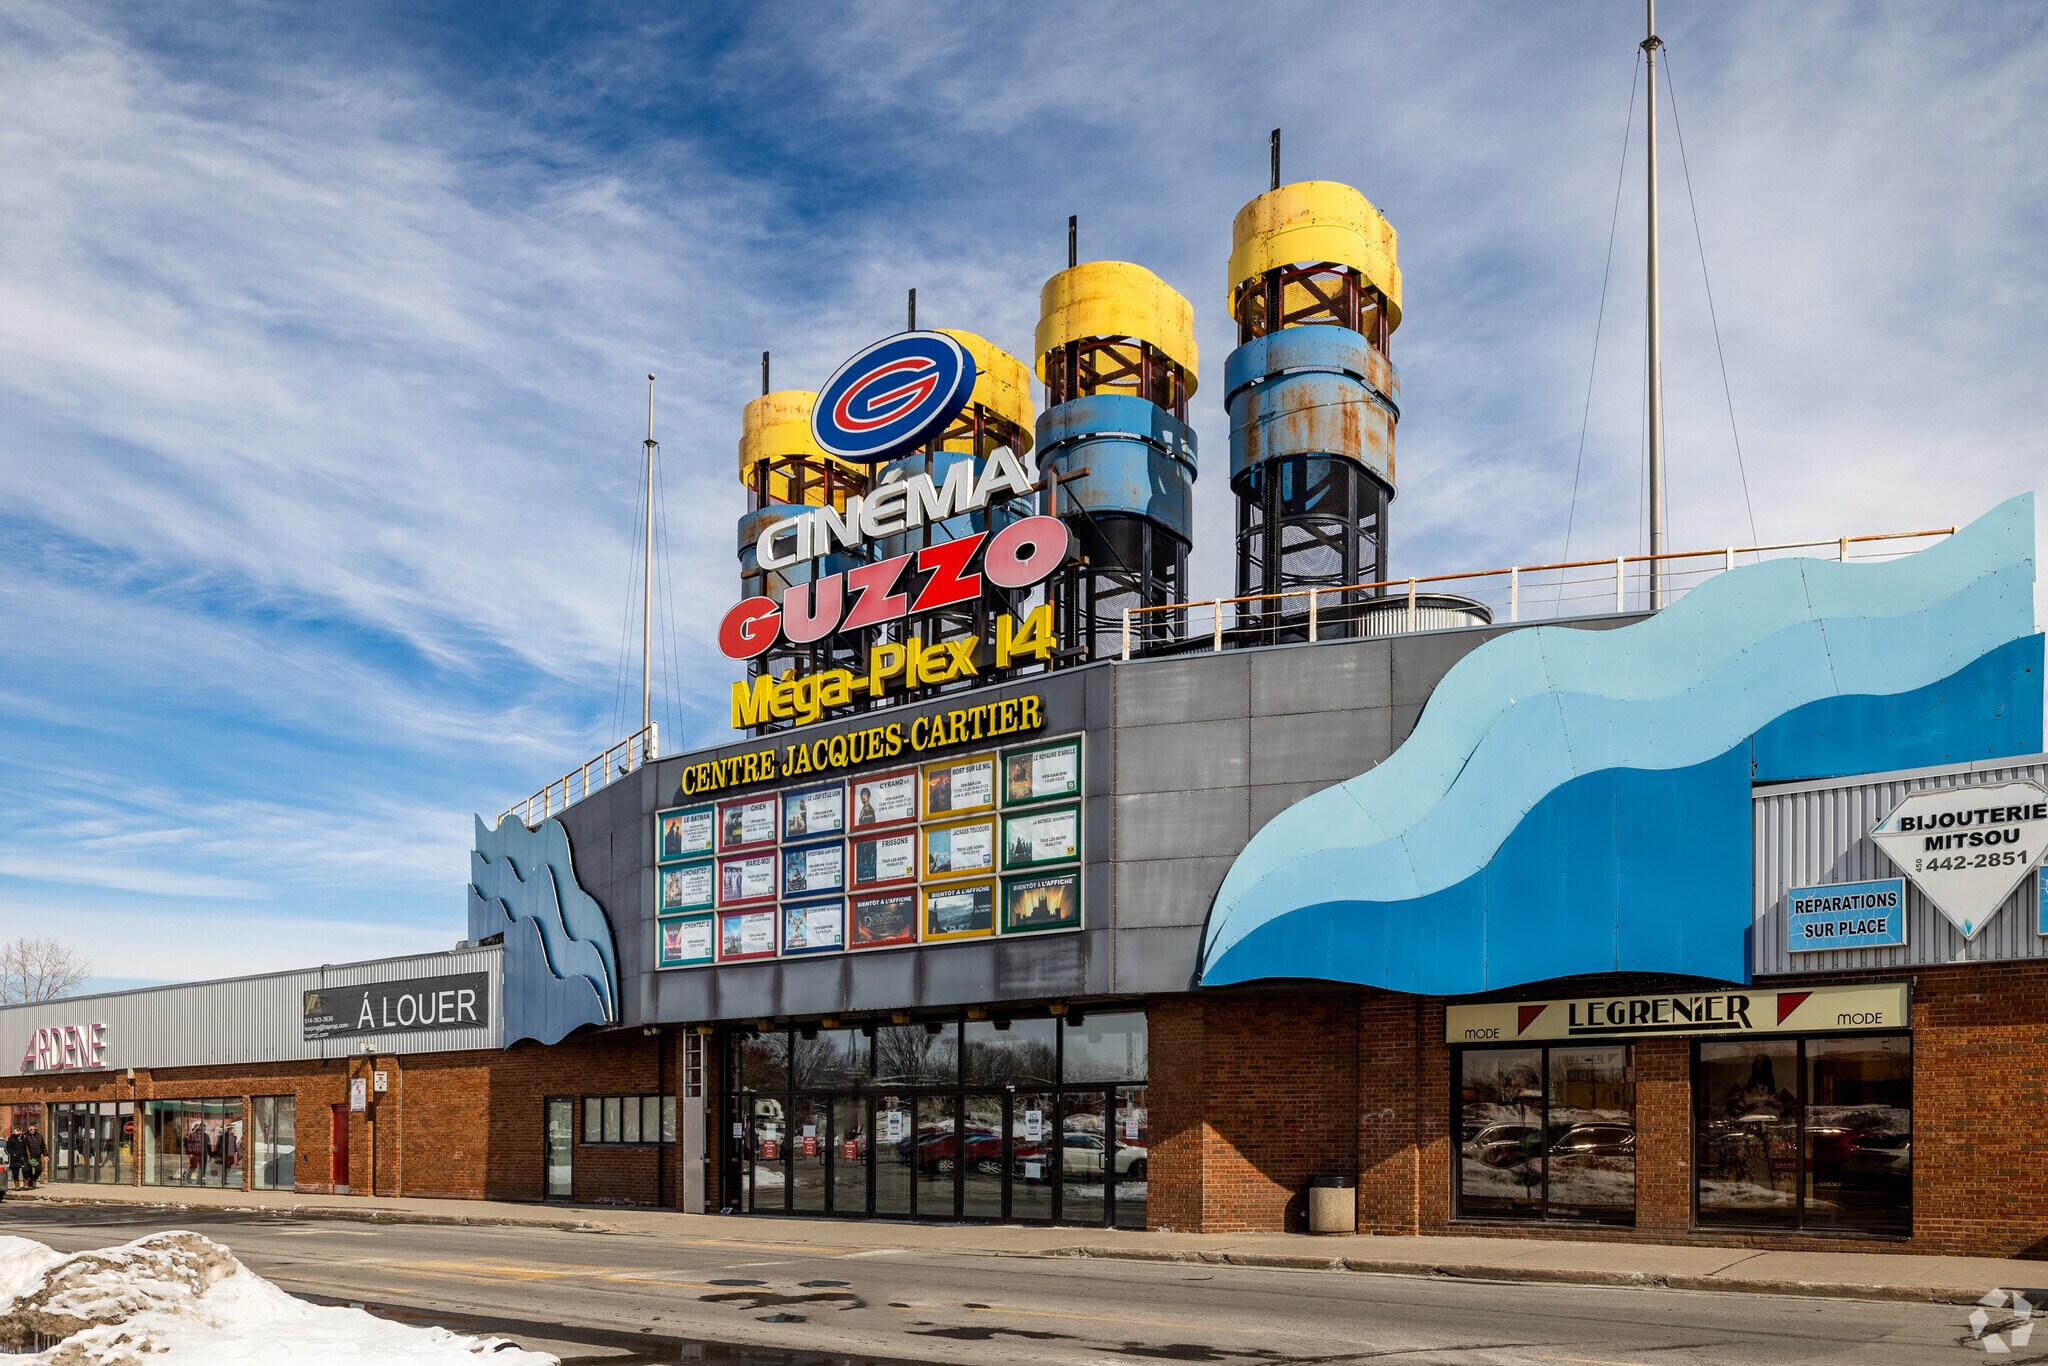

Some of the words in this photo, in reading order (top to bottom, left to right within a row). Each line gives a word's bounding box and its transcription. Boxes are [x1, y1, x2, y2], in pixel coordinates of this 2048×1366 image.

[757, 446, 1034, 571] CINÉMA
[717, 516, 1071, 660] GUZZO
[731, 635, 980, 729] Méga-Plex
[682, 749, 775, 795] CENTRE
[782, 694, 1042, 776] JACQUES-CARTIER
[966, 765, 975, 773] SUR
[879, 779, 903, 789] CYRANO
[691, 814, 710, 822] BATMAN
[751, 803, 766, 811] CHIEN
[1901, 803, 2047, 831] BIJOUTERIE
[882, 837, 908, 847] FRISSONS
[1925, 828, 2020, 851] MITSOU
[1915, 858, 1923, 873] 450
[1926, 850, 2027, 871] 442-2851
[962, 886, 989, 894] L'AFFICHE
[1042, 878, 1073, 886] L'AFFICHE
[886, 896, 911, 904] L'AFFICHE
[1796, 892, 1897, 914] RÉPARATIONS
[1805, 923, 1834, 938] SUR
[1839, 918, 1886, 936] PLACE
[383, 989, 477, 1027] LOUER
[20, 1023, 106, 1072] ARDENE
